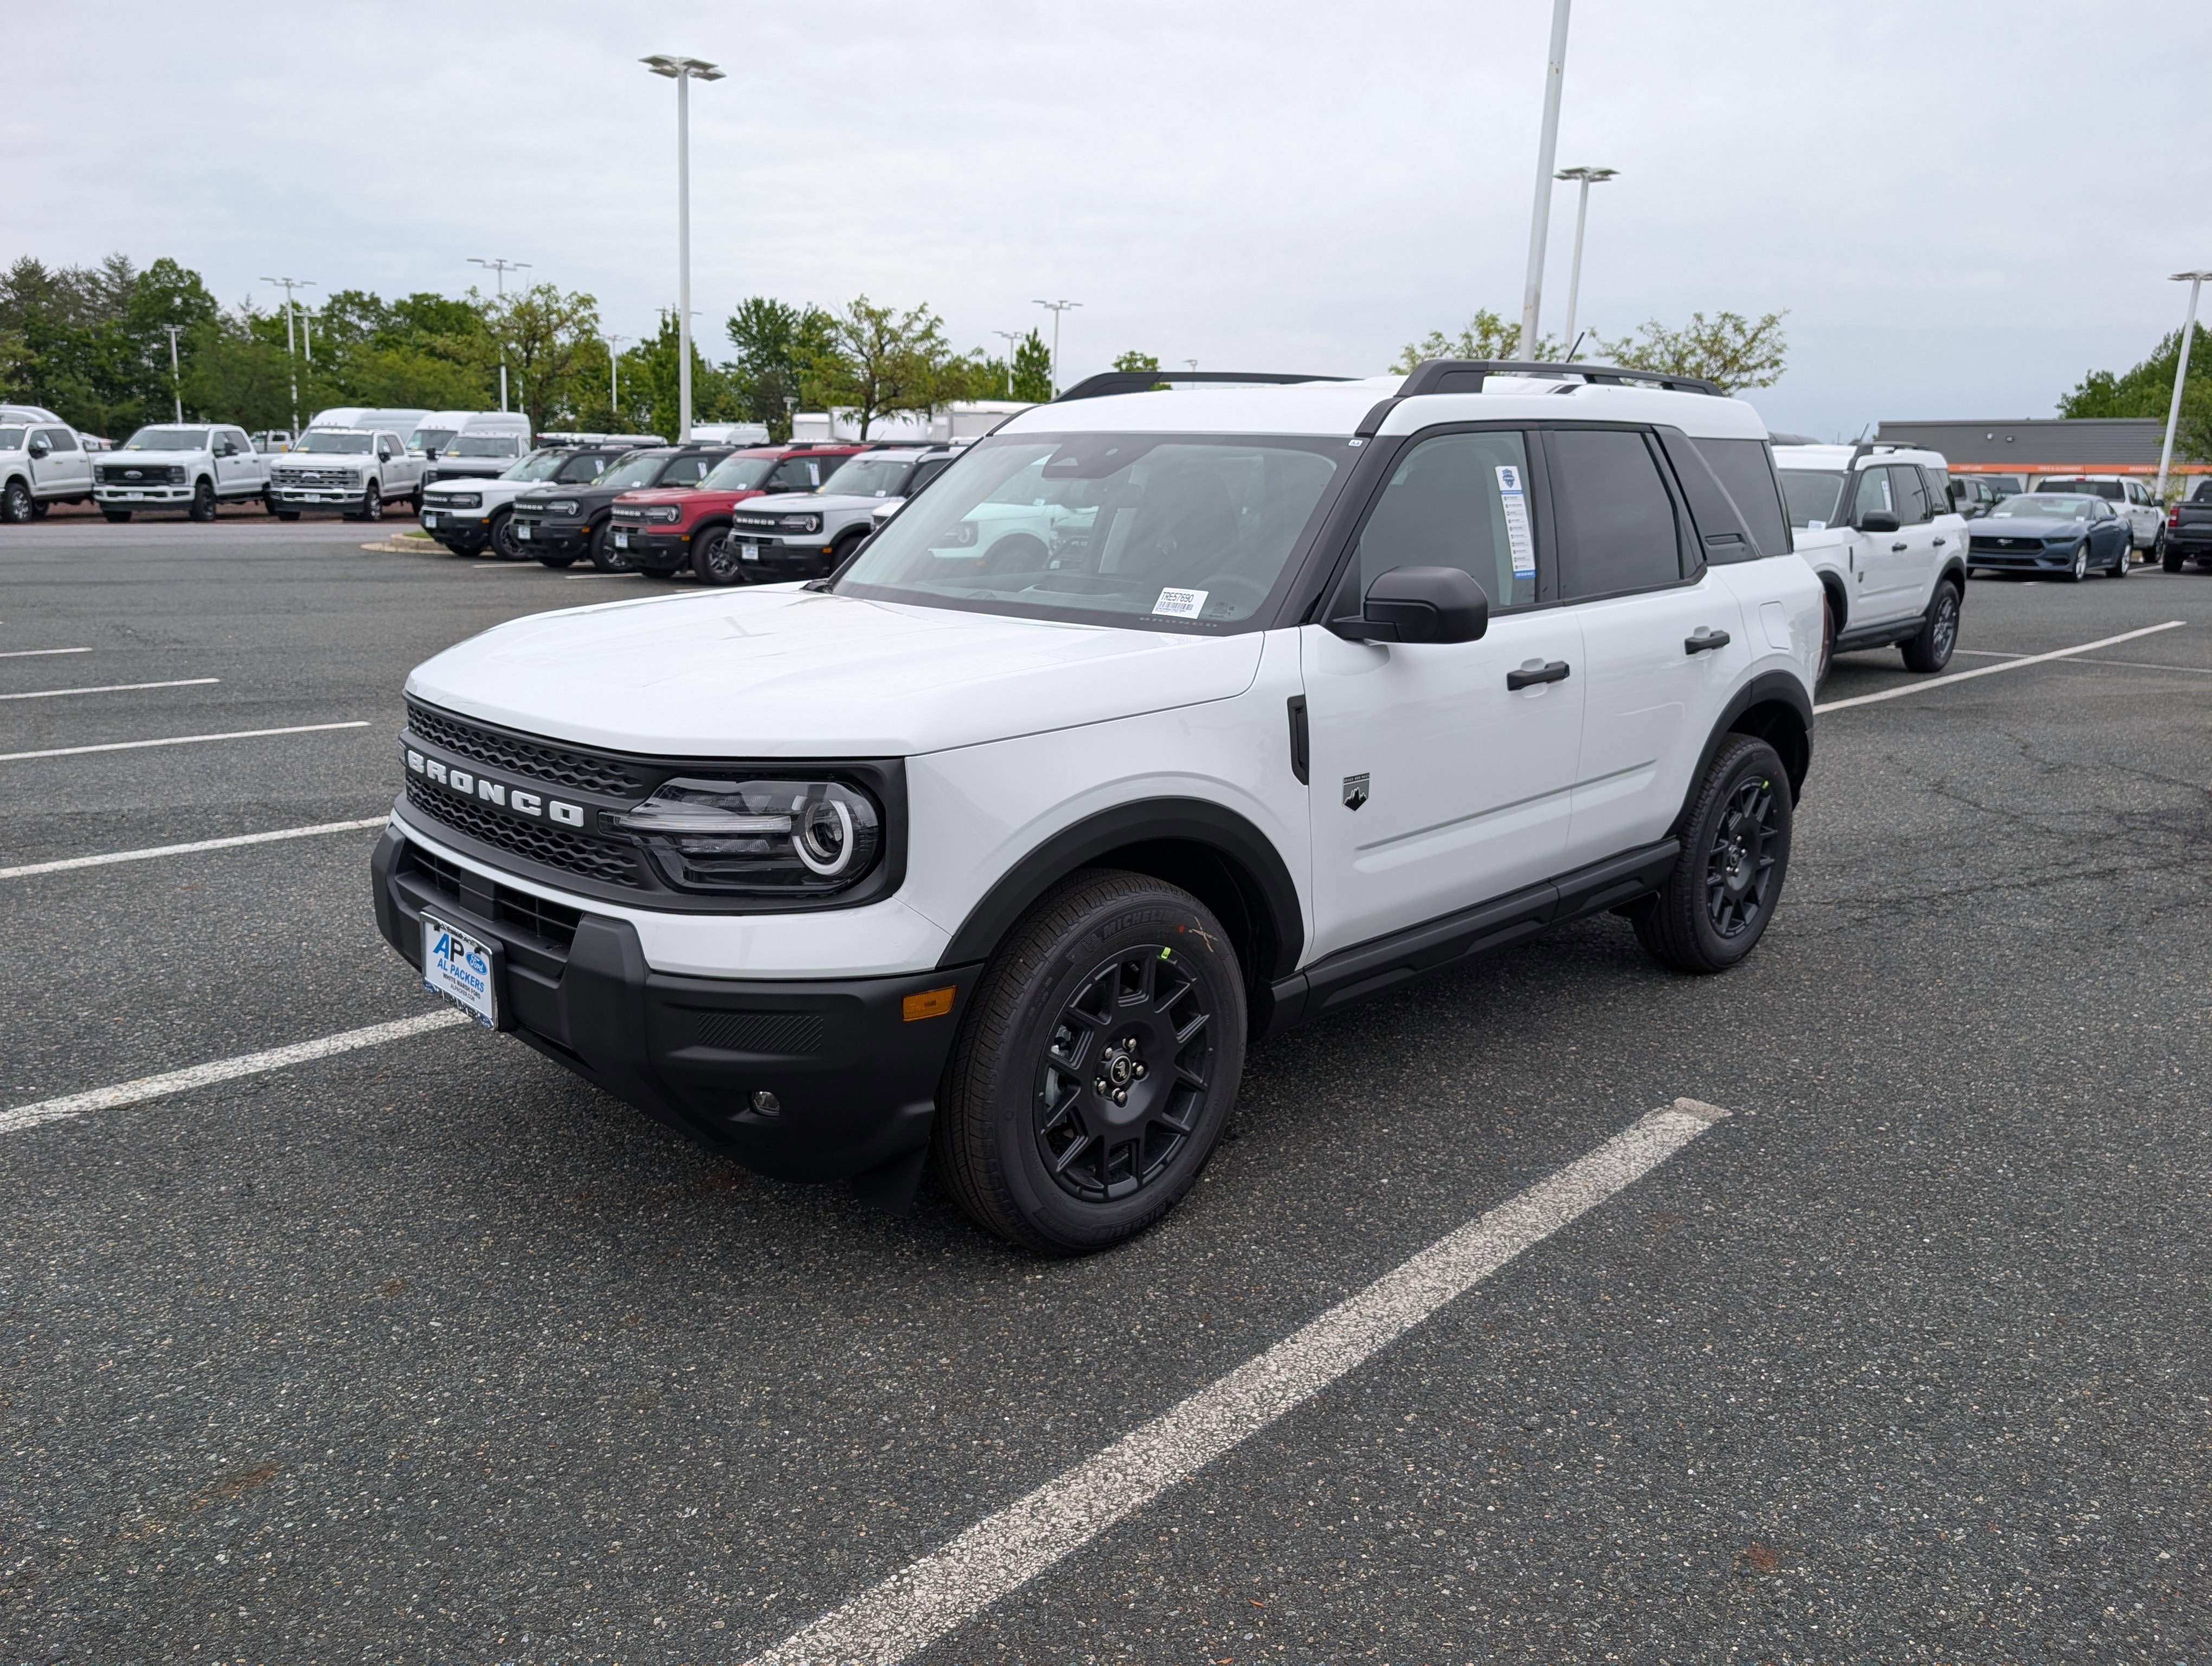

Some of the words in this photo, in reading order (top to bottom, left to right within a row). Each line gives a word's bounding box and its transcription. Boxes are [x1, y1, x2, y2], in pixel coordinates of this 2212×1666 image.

[1161, 591, 1194, 603] TRE57690
[408, 749, 584, 828] BRONCO
[1103, 910, 1175, 939] MICHELIN
[433, 933, 465, 963] AP
[437, 958, 448, 972] AL
[449, 963, 485, 993] PACKERS
[469, 954, 484, 972] Ford
[443, 972, 456, 984] WHITE
[456, 979, 471, 992] MARSH
[471, 988, 481, 999] FORD
